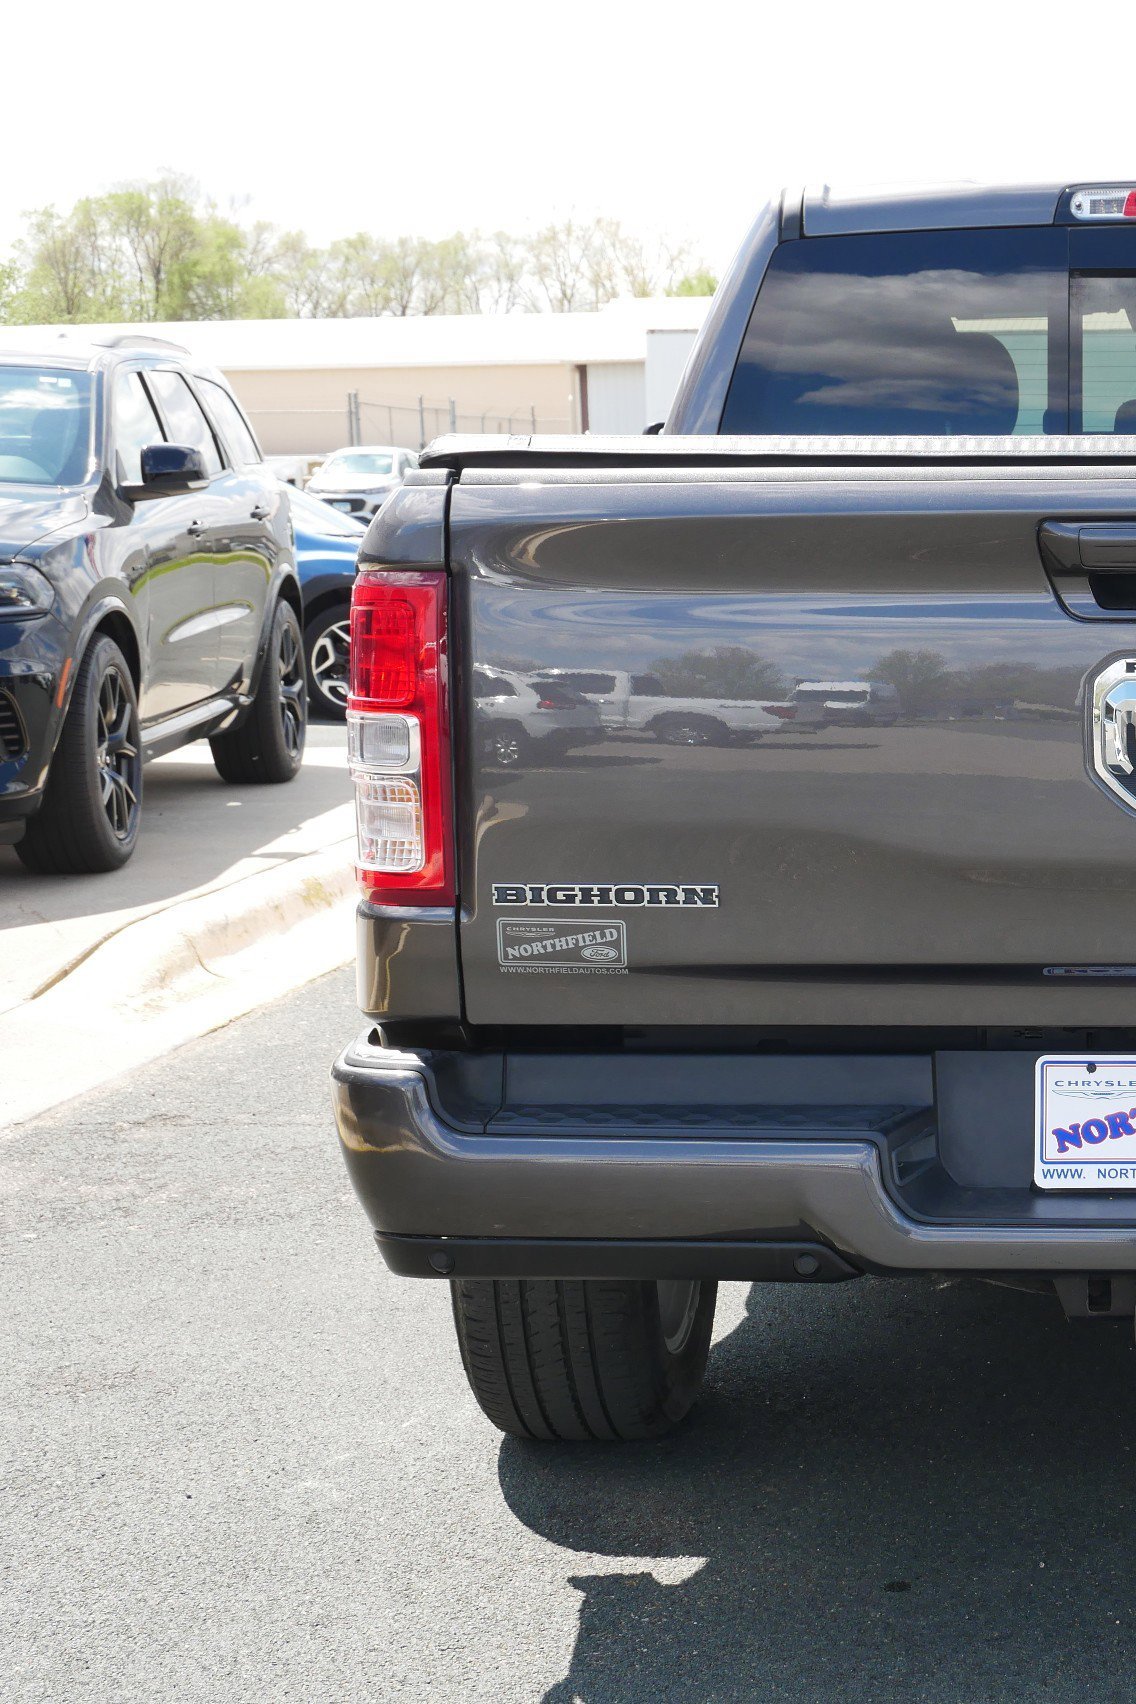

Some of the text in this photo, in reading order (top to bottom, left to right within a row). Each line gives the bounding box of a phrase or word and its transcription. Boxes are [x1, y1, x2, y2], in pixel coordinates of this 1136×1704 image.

[492, 884, 720, 907] BIGHORN
[506, 928, 618, 959] NORTHFIELD
[500, 966, 629, 975] WWW.NORTHFIELDAUTOS.COM
[1041, 1168, 1086, 1180] WWW.
